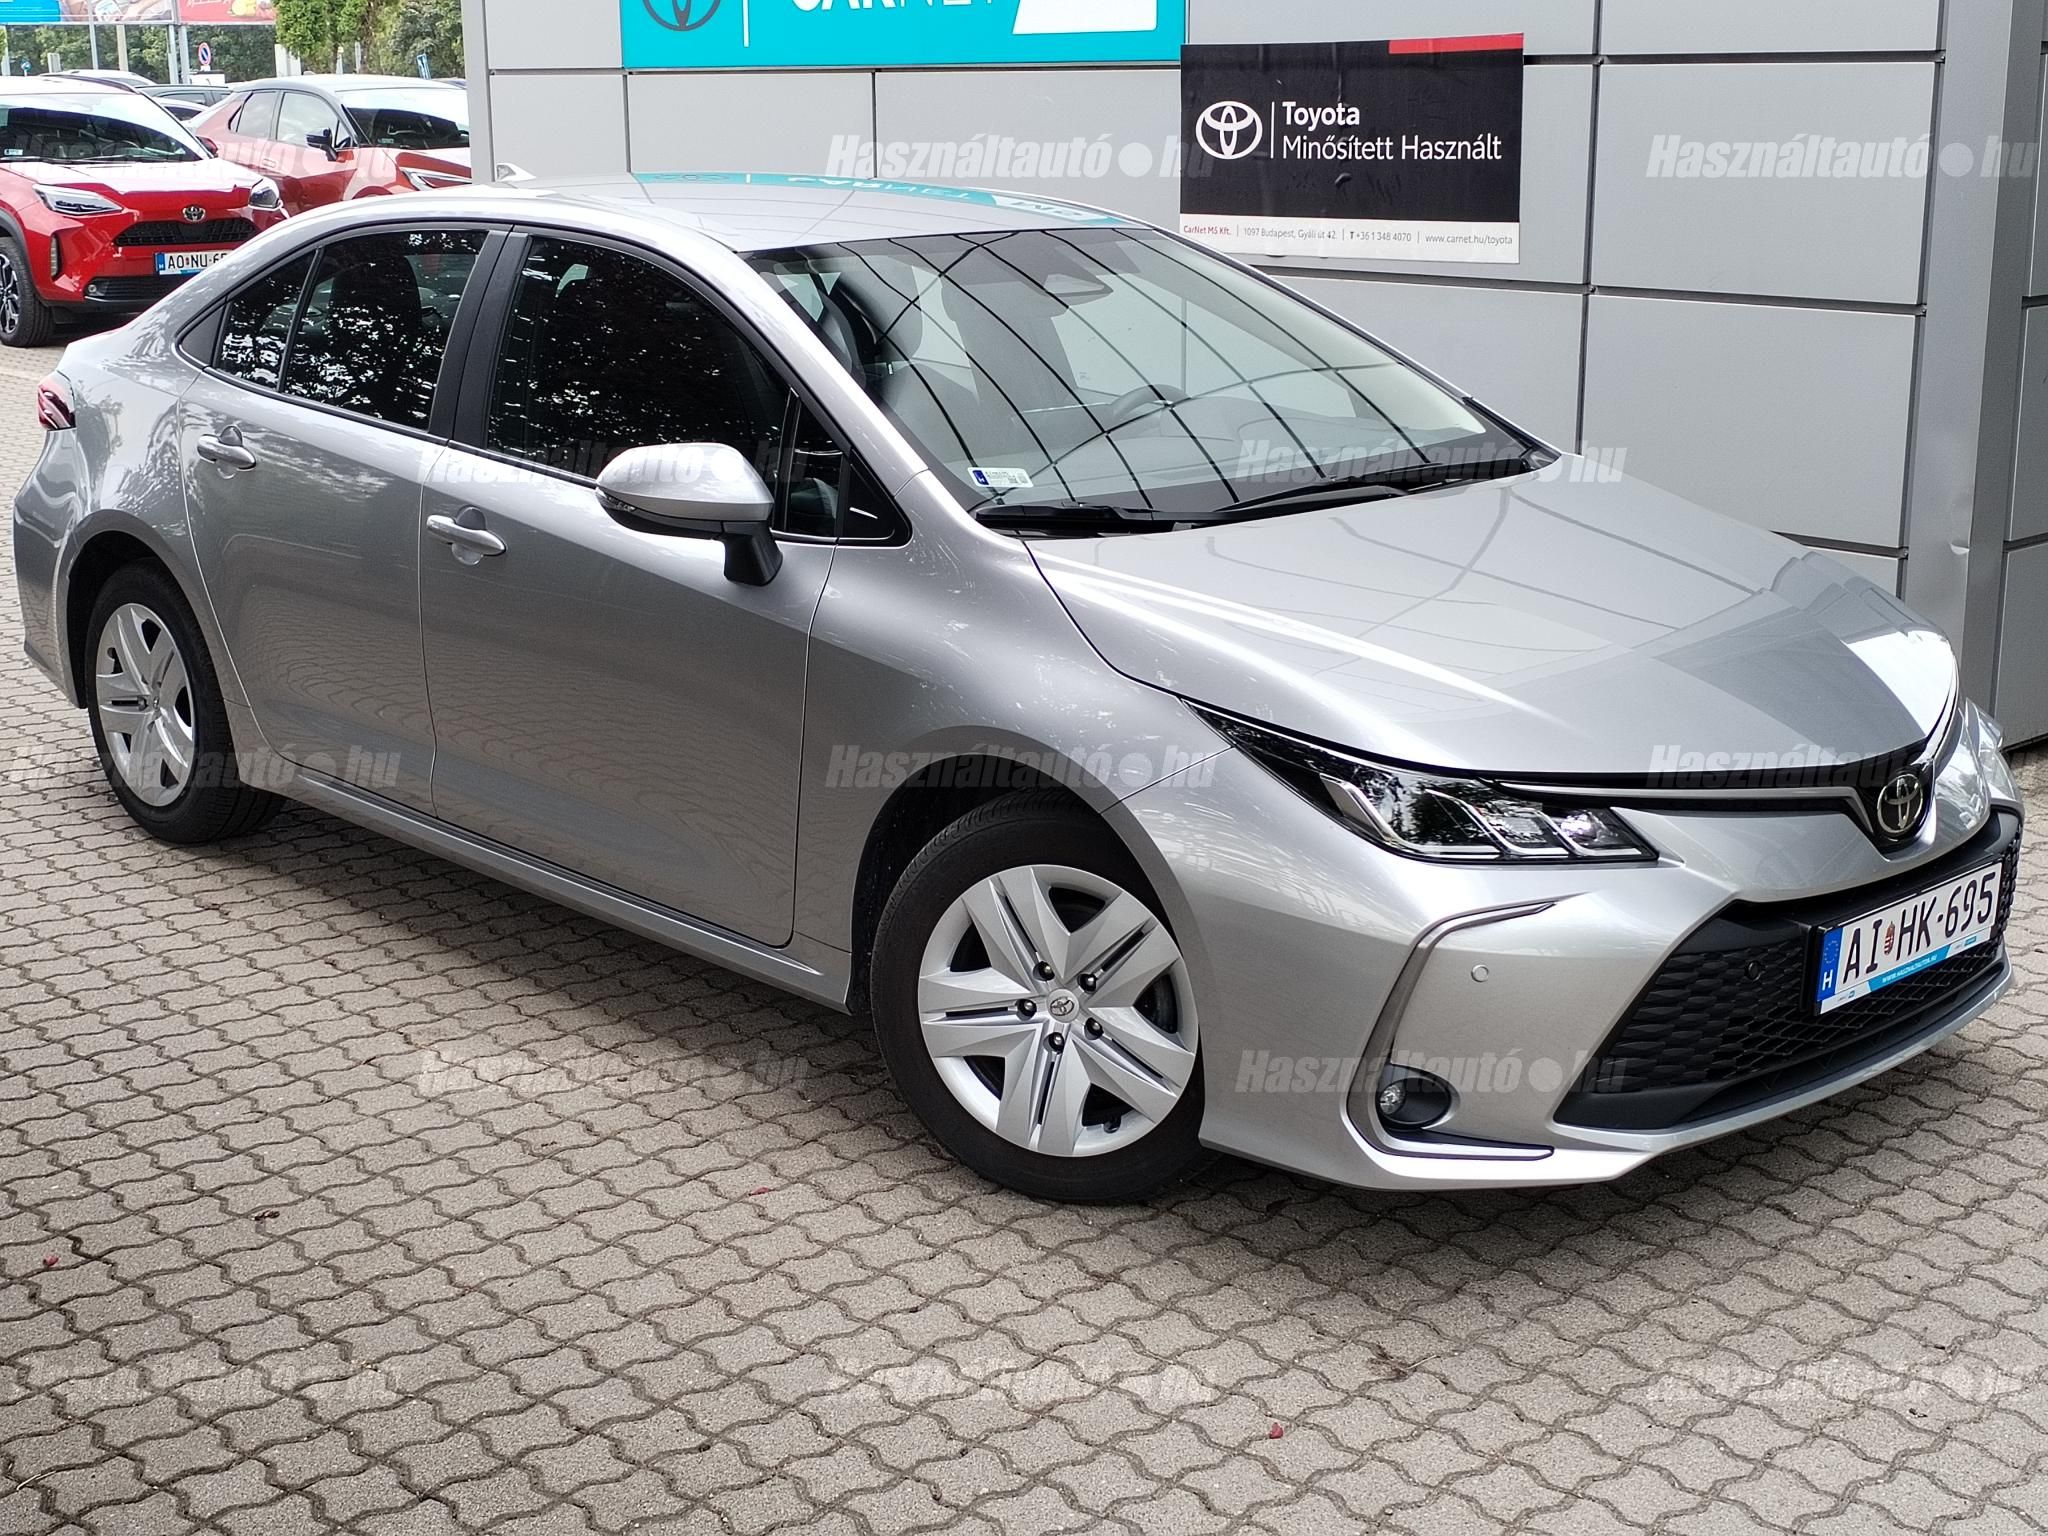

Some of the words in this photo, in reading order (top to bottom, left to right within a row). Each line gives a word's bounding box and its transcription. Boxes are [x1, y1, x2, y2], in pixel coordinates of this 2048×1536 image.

[1282, 101, 1360, 131] Toyota
[1283, 134, 1394, 160] Minősített
[1401, 133, 1502, 160] Használt
[1183, 225, 1206, 235] CarNet
[1219, 226, 1231, 236] Kft.
[1244, 227, 1260, 237] 1097
[1261, 228, 1295, 239] Budapest,
[1392, 232, 1411, 242] 4070
[1425, 234, 1513, 246] www.carnet.hu/toyota
[1843, 919, 1883, 984] AI
[1896, 871, 1996, 961] HK-695
[1822, 970, 1833, 991] H
